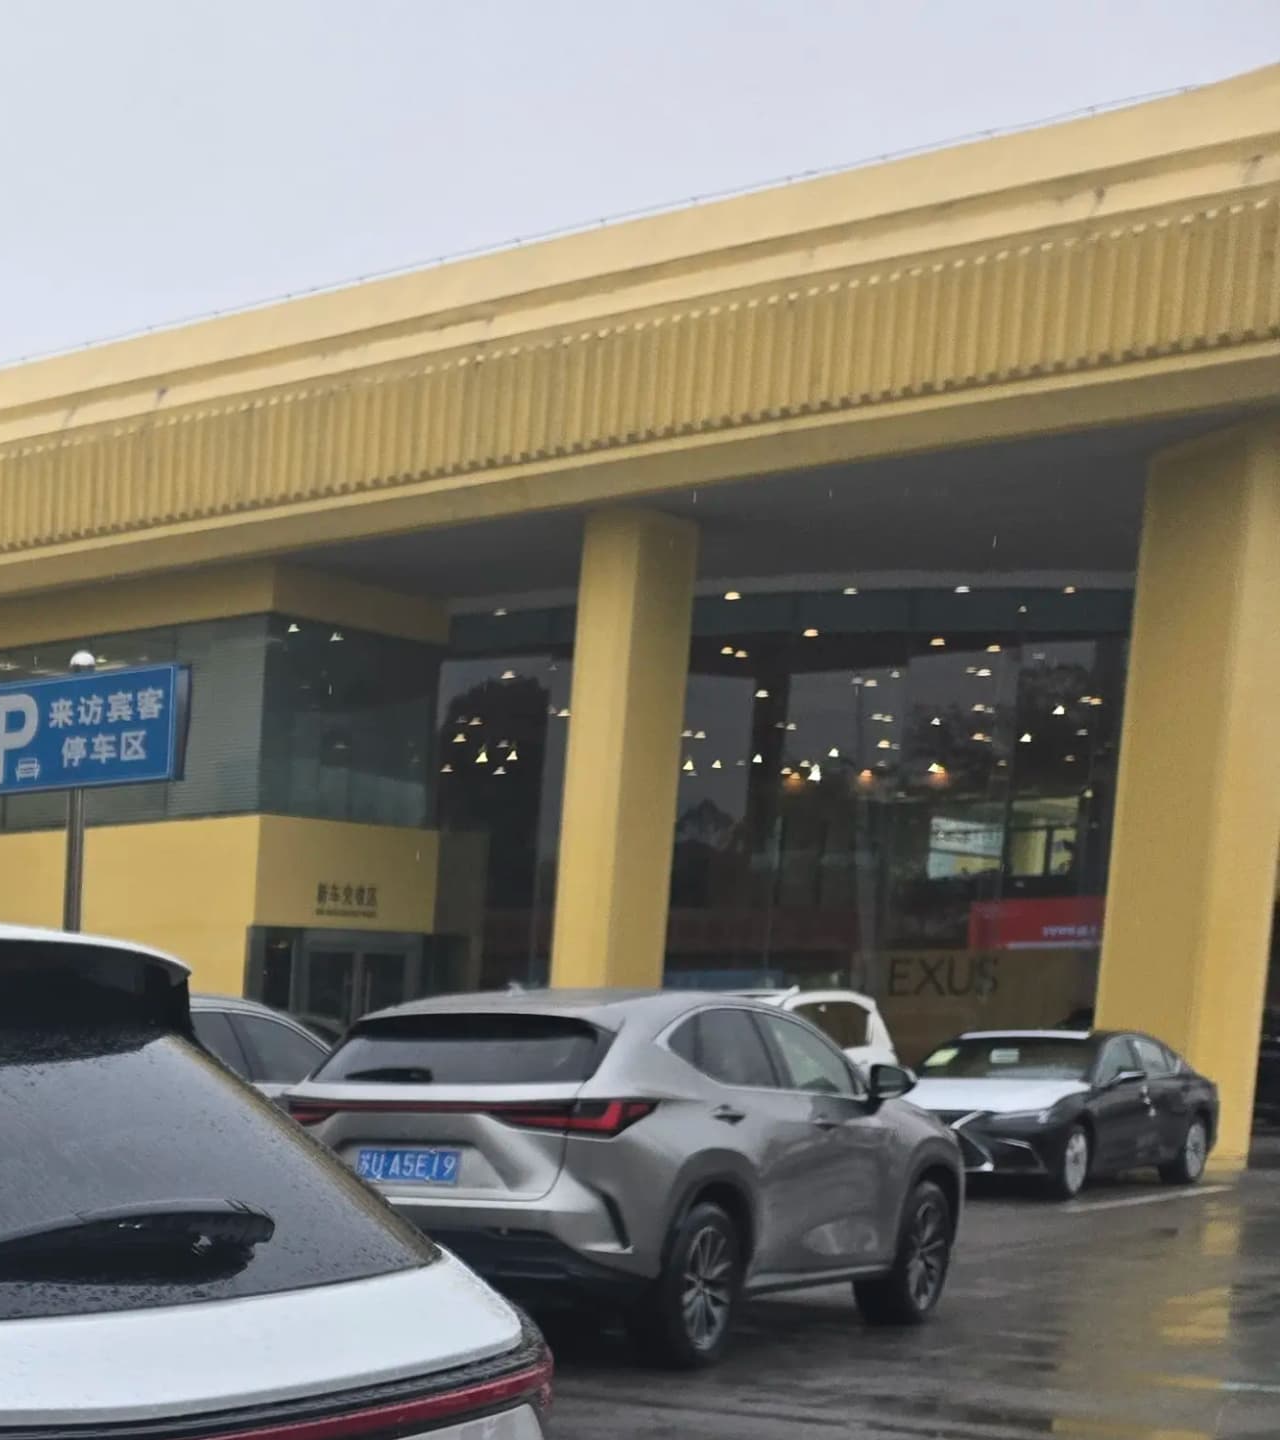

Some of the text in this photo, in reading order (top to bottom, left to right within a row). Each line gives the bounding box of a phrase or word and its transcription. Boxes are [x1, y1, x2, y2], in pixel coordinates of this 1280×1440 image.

[48, 686, 164, 729] 来访宾客
[61, 730, 147, 769] 停车区
[890, 956, 999, 998] EXUS
